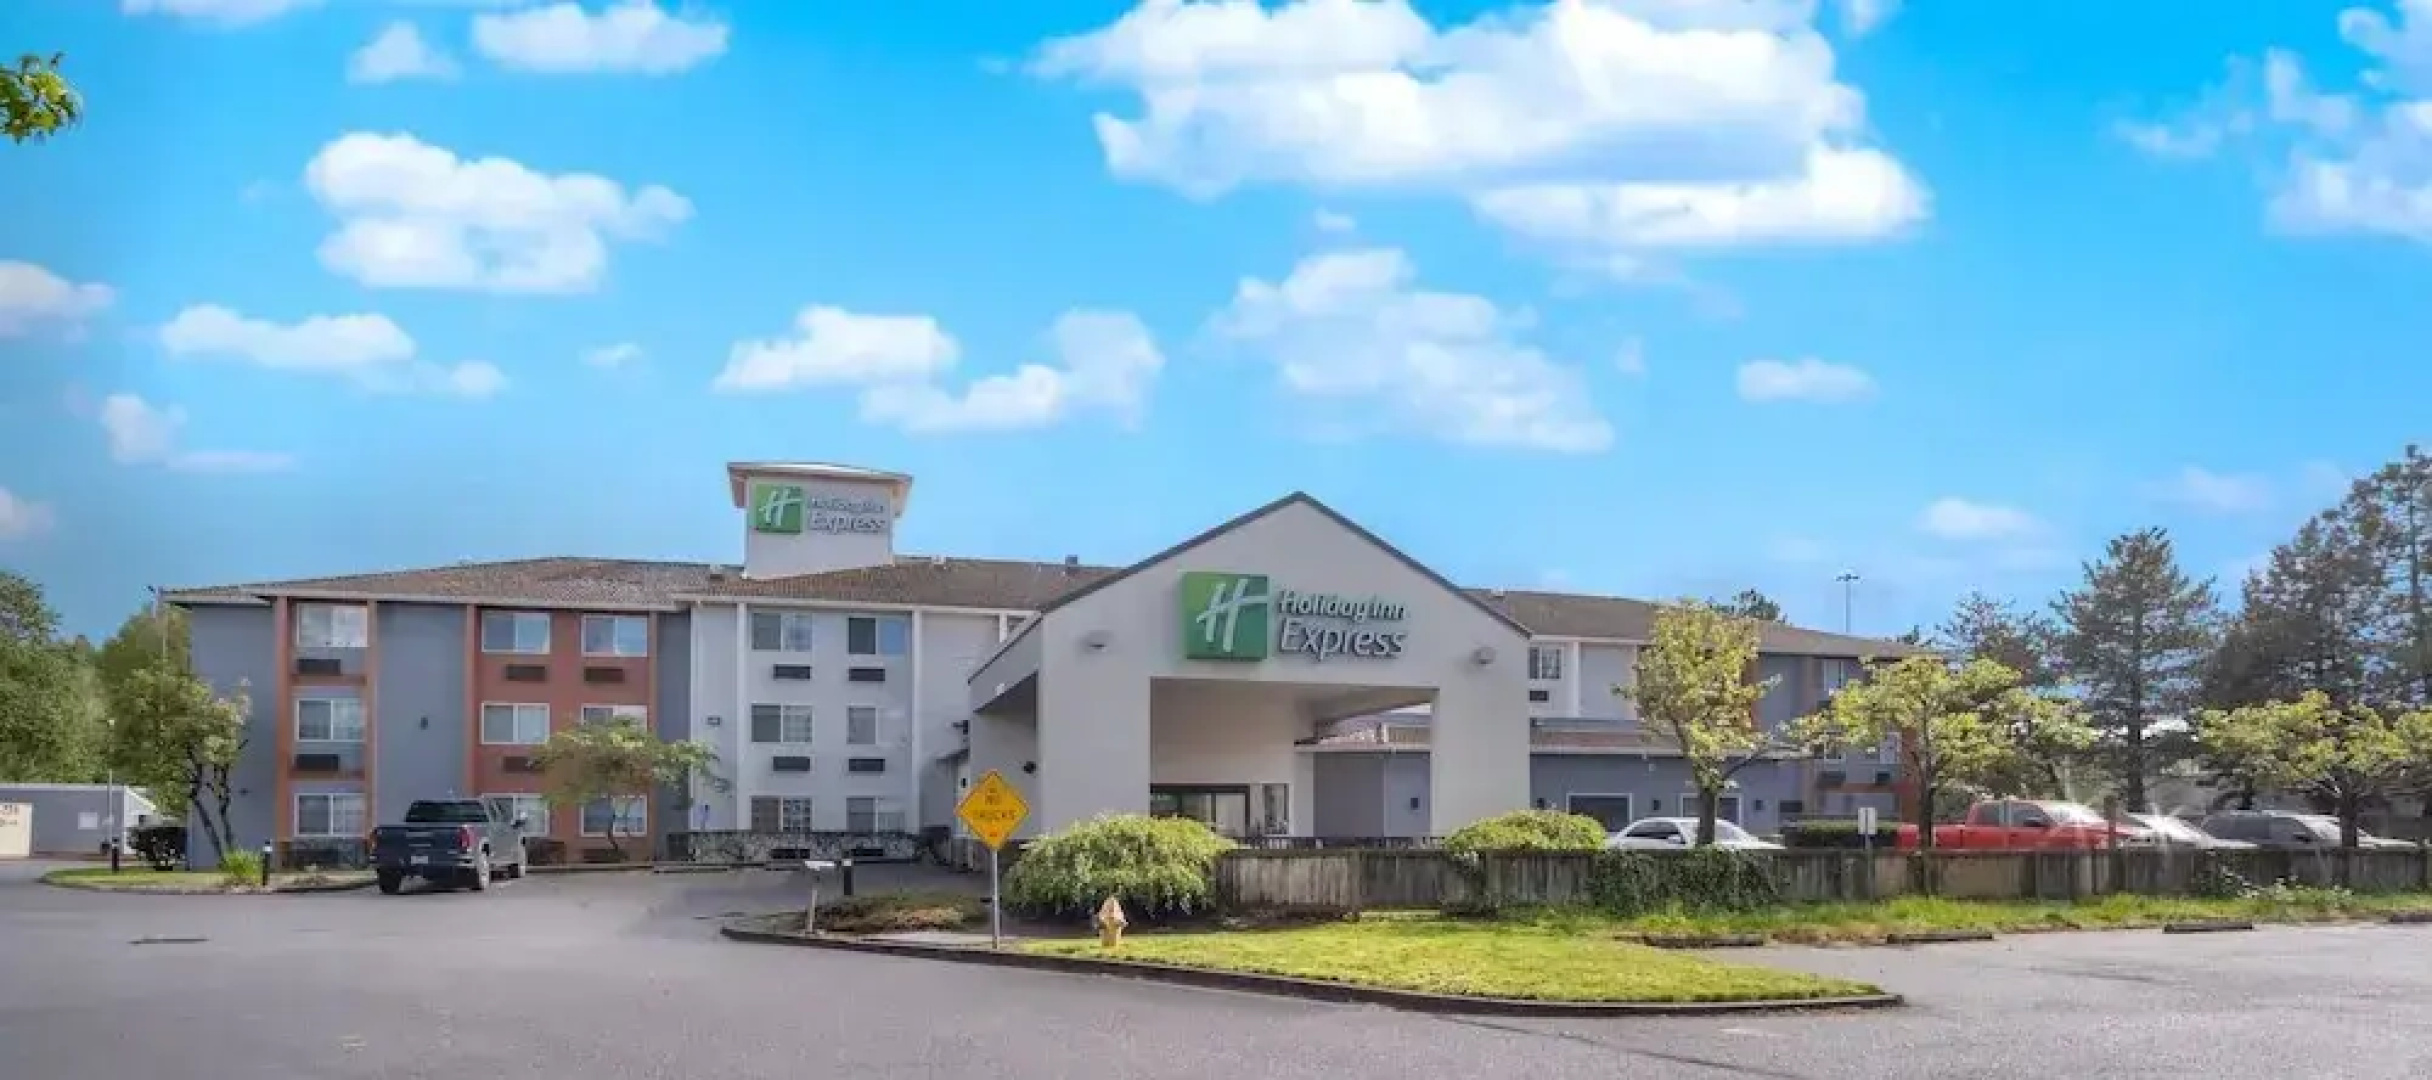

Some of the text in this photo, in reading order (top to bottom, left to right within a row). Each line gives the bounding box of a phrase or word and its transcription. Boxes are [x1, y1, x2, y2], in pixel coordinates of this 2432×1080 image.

[808, 511, 886, 535] Express
[1279, 590, 1406, 622] Holiday Inn
[1279, 616, 1408, 662] Express
[984, 794, 1002, 806] NO
